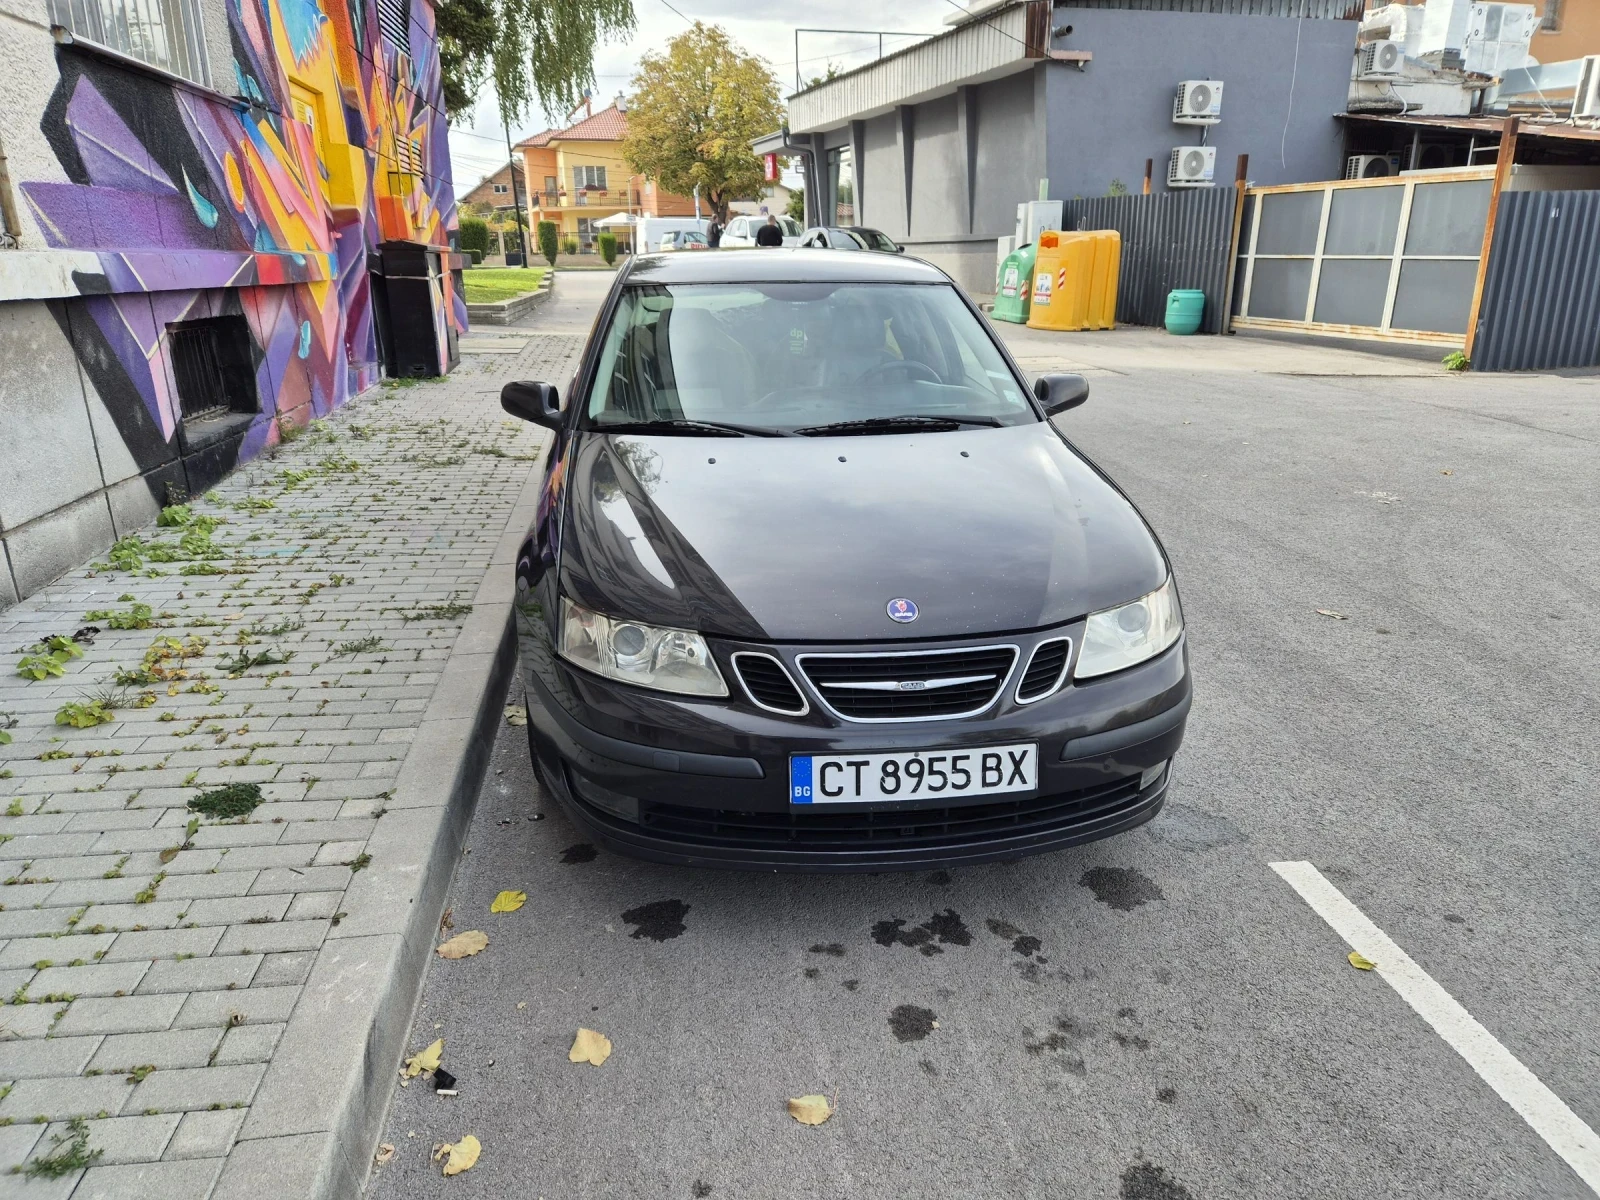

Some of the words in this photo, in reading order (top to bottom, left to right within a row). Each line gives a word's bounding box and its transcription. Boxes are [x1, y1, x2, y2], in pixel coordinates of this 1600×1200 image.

[794, 786, 811, 797] BG
[819, 760, 870, 797] CT
[879, 755, 972, 795] 8955
[981, 750, 1029, 788] BX
